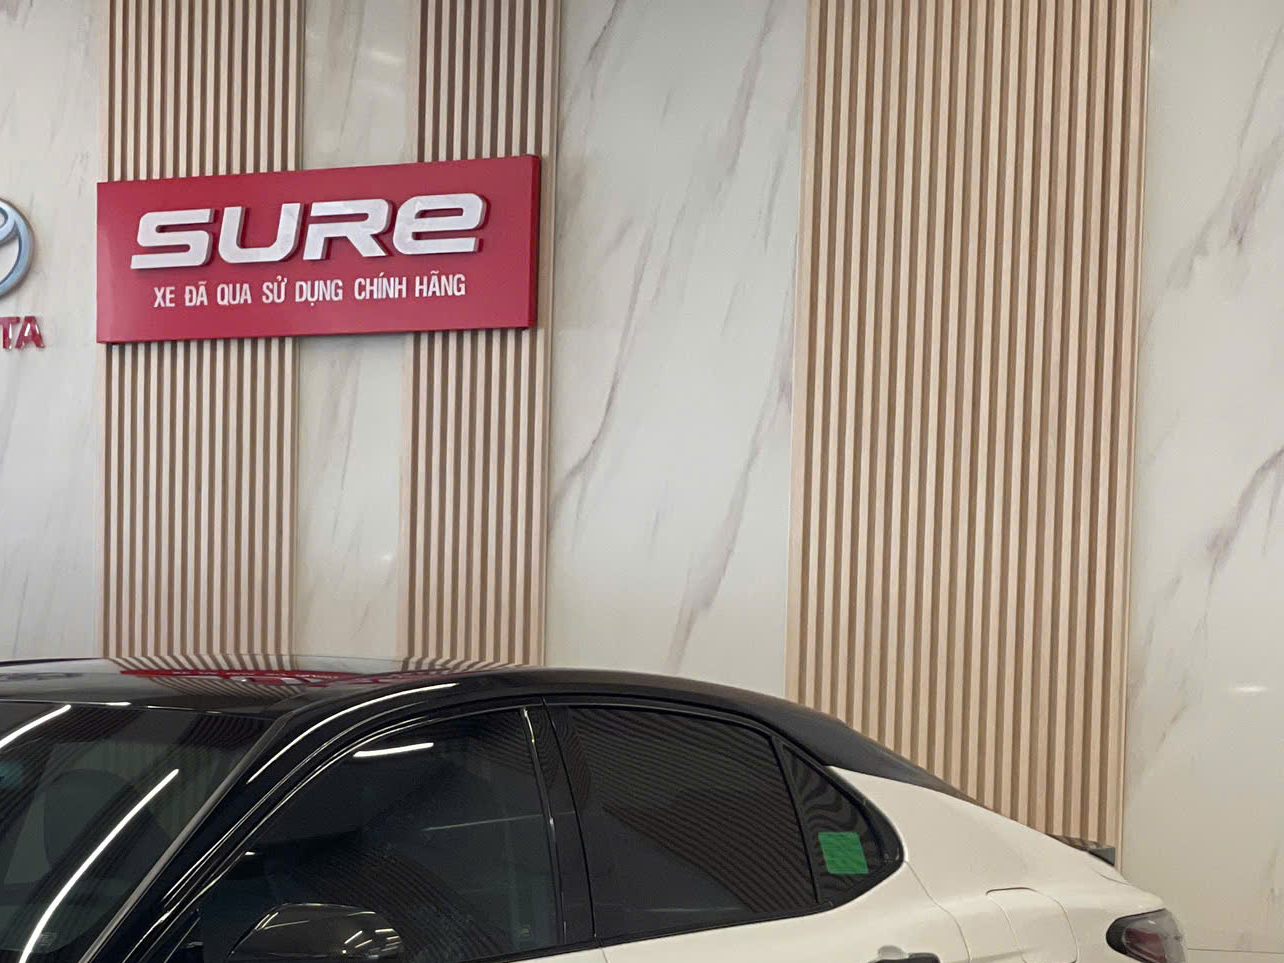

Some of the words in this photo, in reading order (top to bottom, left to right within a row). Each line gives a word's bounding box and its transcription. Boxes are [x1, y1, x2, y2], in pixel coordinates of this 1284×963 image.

[153, 286, 175, 307] XE
[185, 281, 208, 306] ĐÃ
[216, 283, 252, 305] QUA
[262, 275, 288, 303] SỬ
[295, 279, 343, 306] DỤNG
[354, 272, 407, 300] CHÍNH
[414, 270, 467, 297] HÃNG
